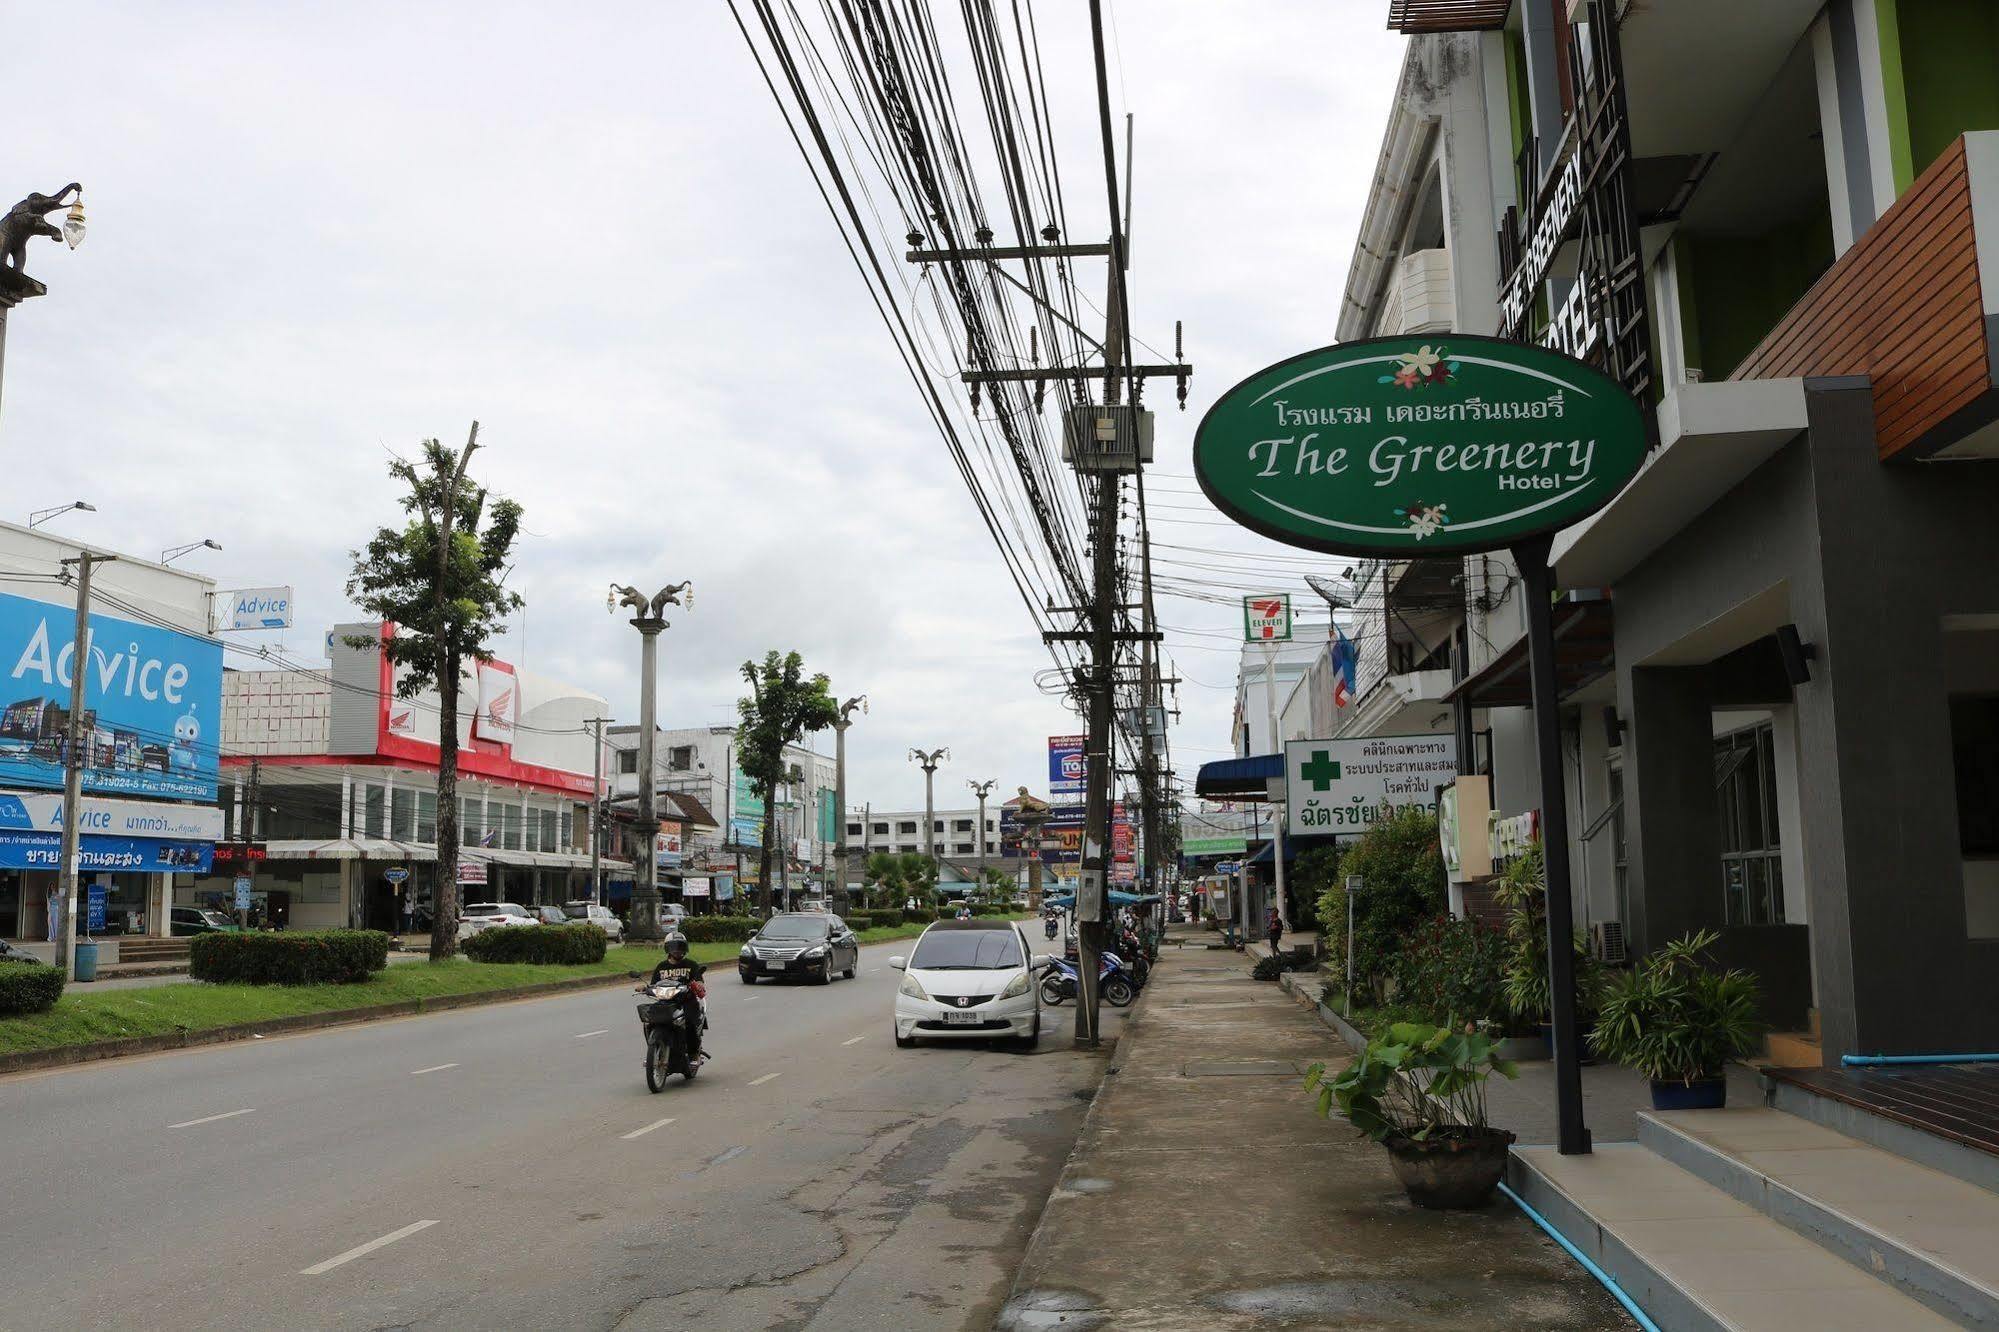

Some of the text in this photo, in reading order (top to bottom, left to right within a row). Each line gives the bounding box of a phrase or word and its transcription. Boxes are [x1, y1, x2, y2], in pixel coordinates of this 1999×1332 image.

[1503, 141, 1583, 336] THE GREENERY
[1273, 389, 1566, 427] โรงแรม เดอะกรีนเนอรี่
[1248, 433, 1596, 488] The Greenery
[1498, 473, 1561, 491] Hotel
[236, 597, 287, 613] Advice
[1253, 600, 1281, 618] 7
[1362, 741, 1446, 757] คลินิกเฉพาะทาง
[1384, 776, 1428, 794] โรคทั่วไป
[51, 804, 112, 828] Avice
